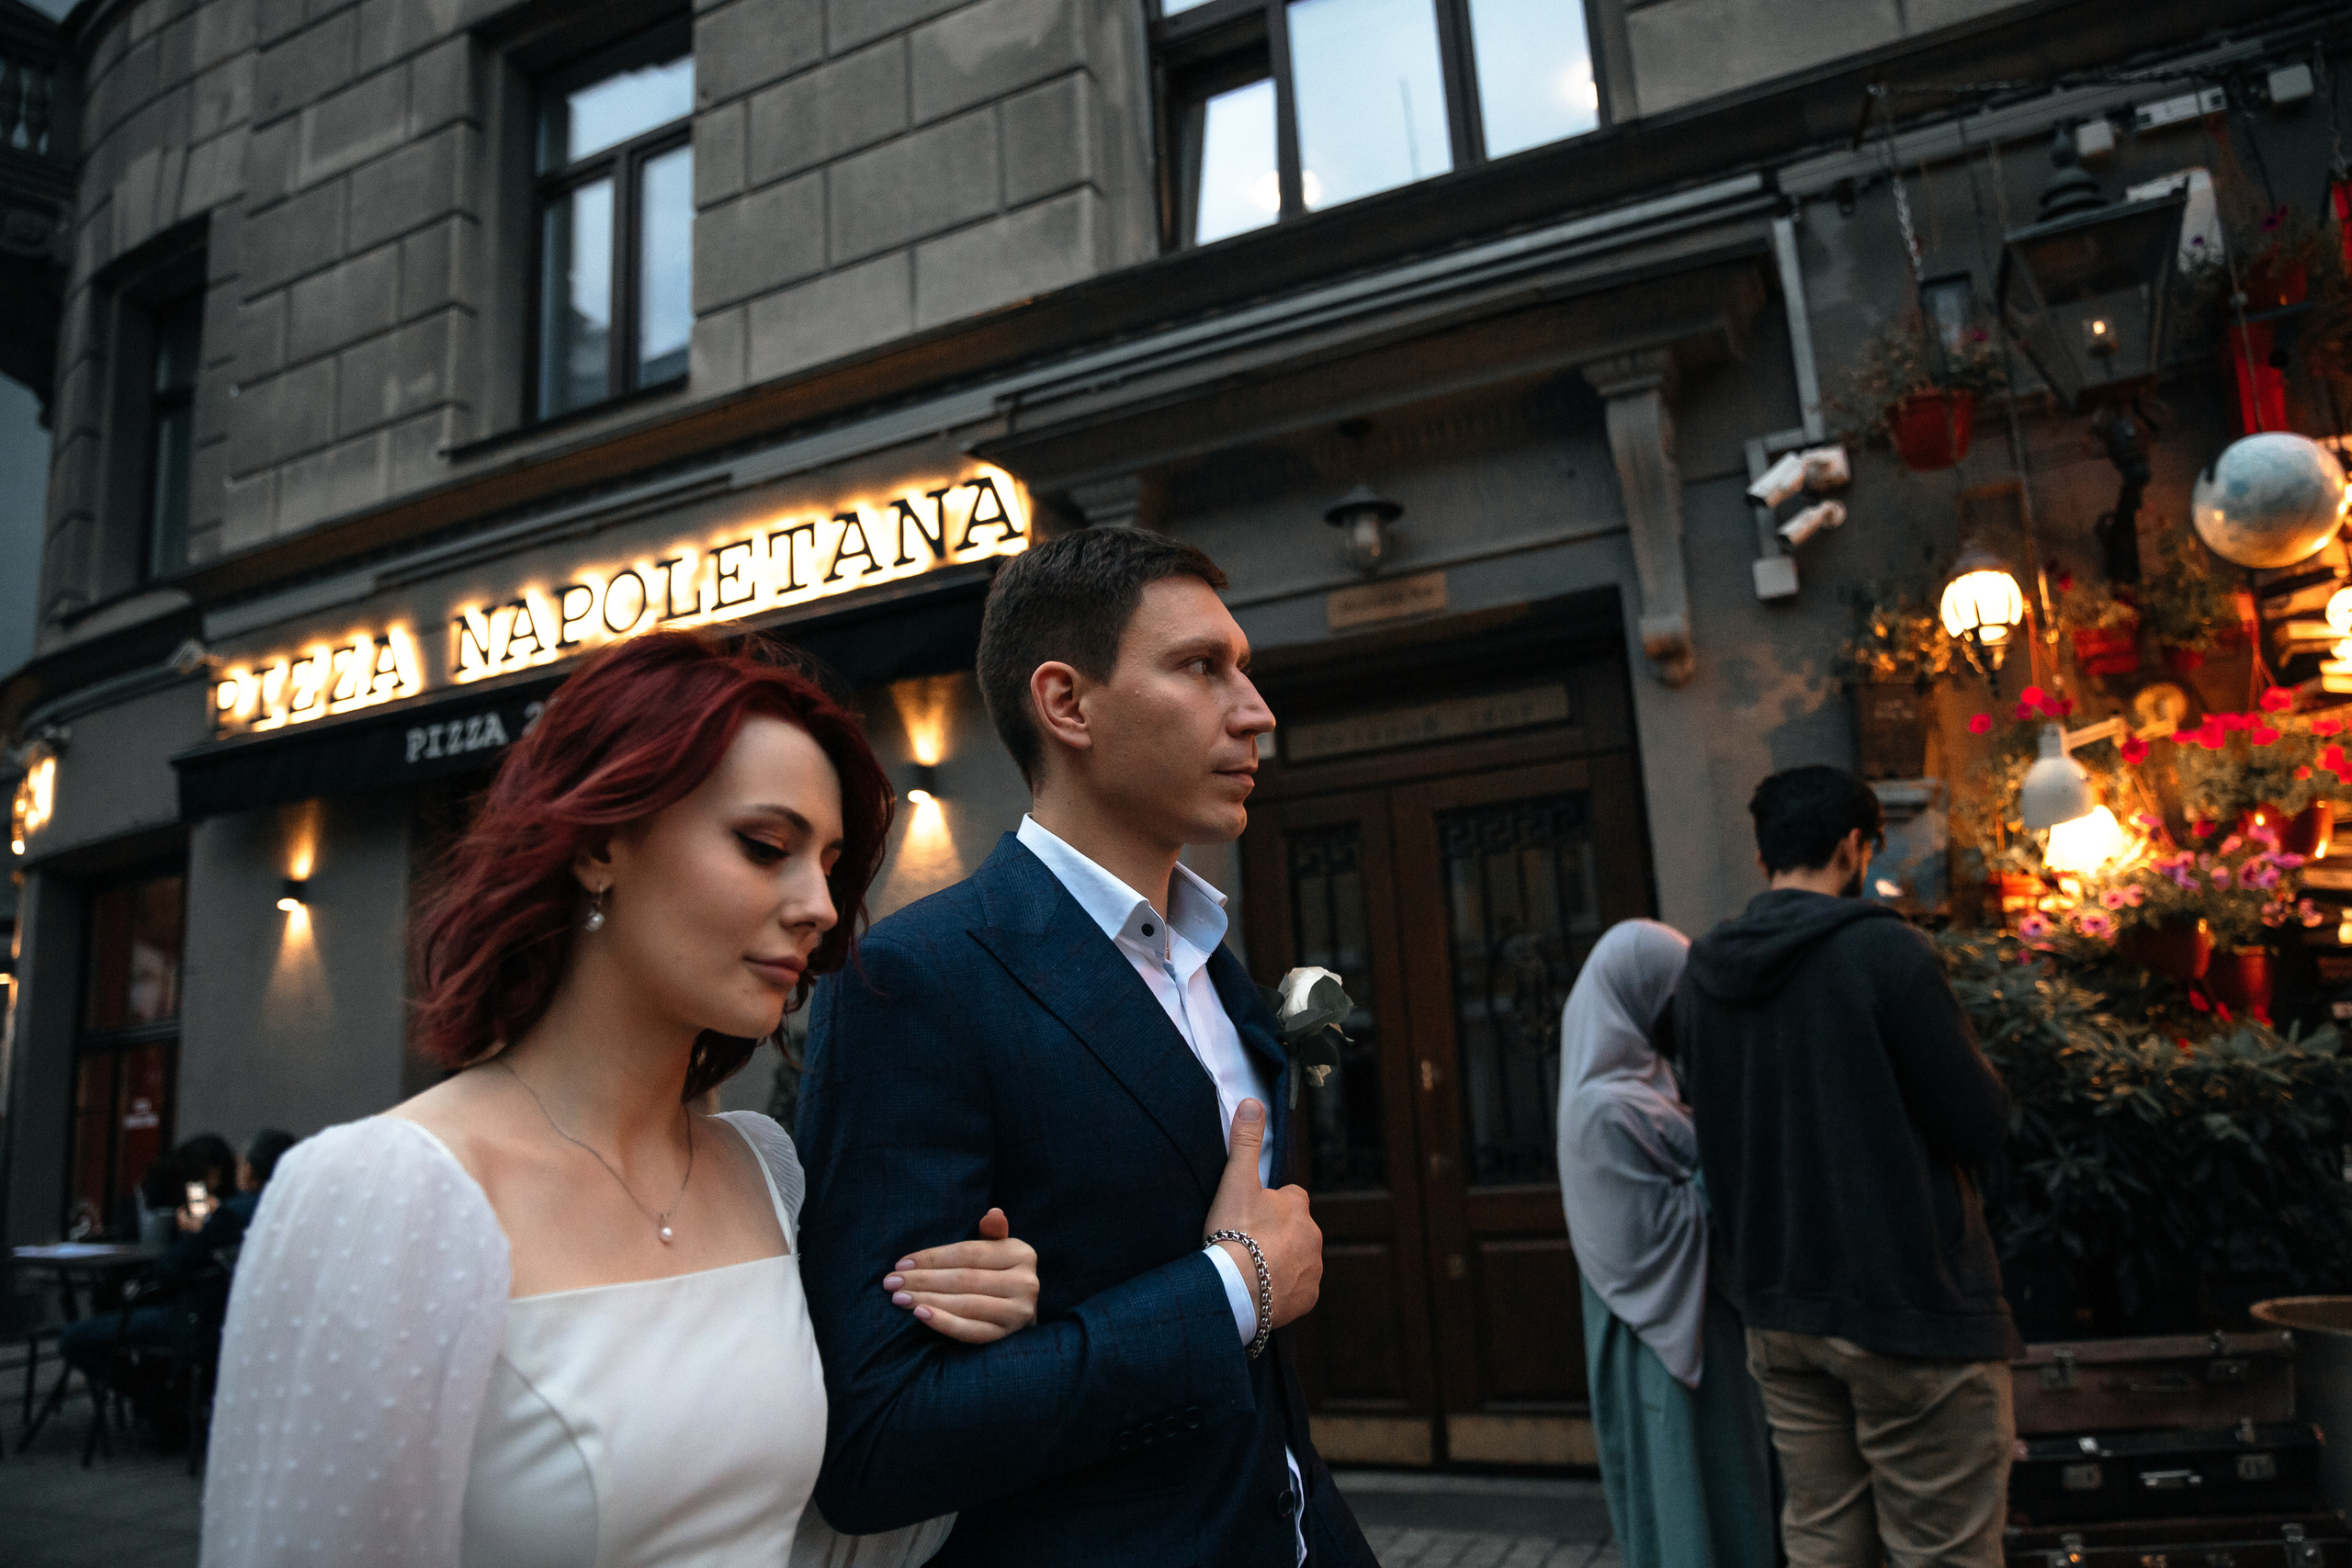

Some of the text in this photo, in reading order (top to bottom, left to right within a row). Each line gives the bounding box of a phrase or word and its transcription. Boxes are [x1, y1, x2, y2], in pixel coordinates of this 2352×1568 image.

[211, 476, 1024, 734] PIZZA NAPOLETANA
[405, 711, 508, 763] PIZZA
